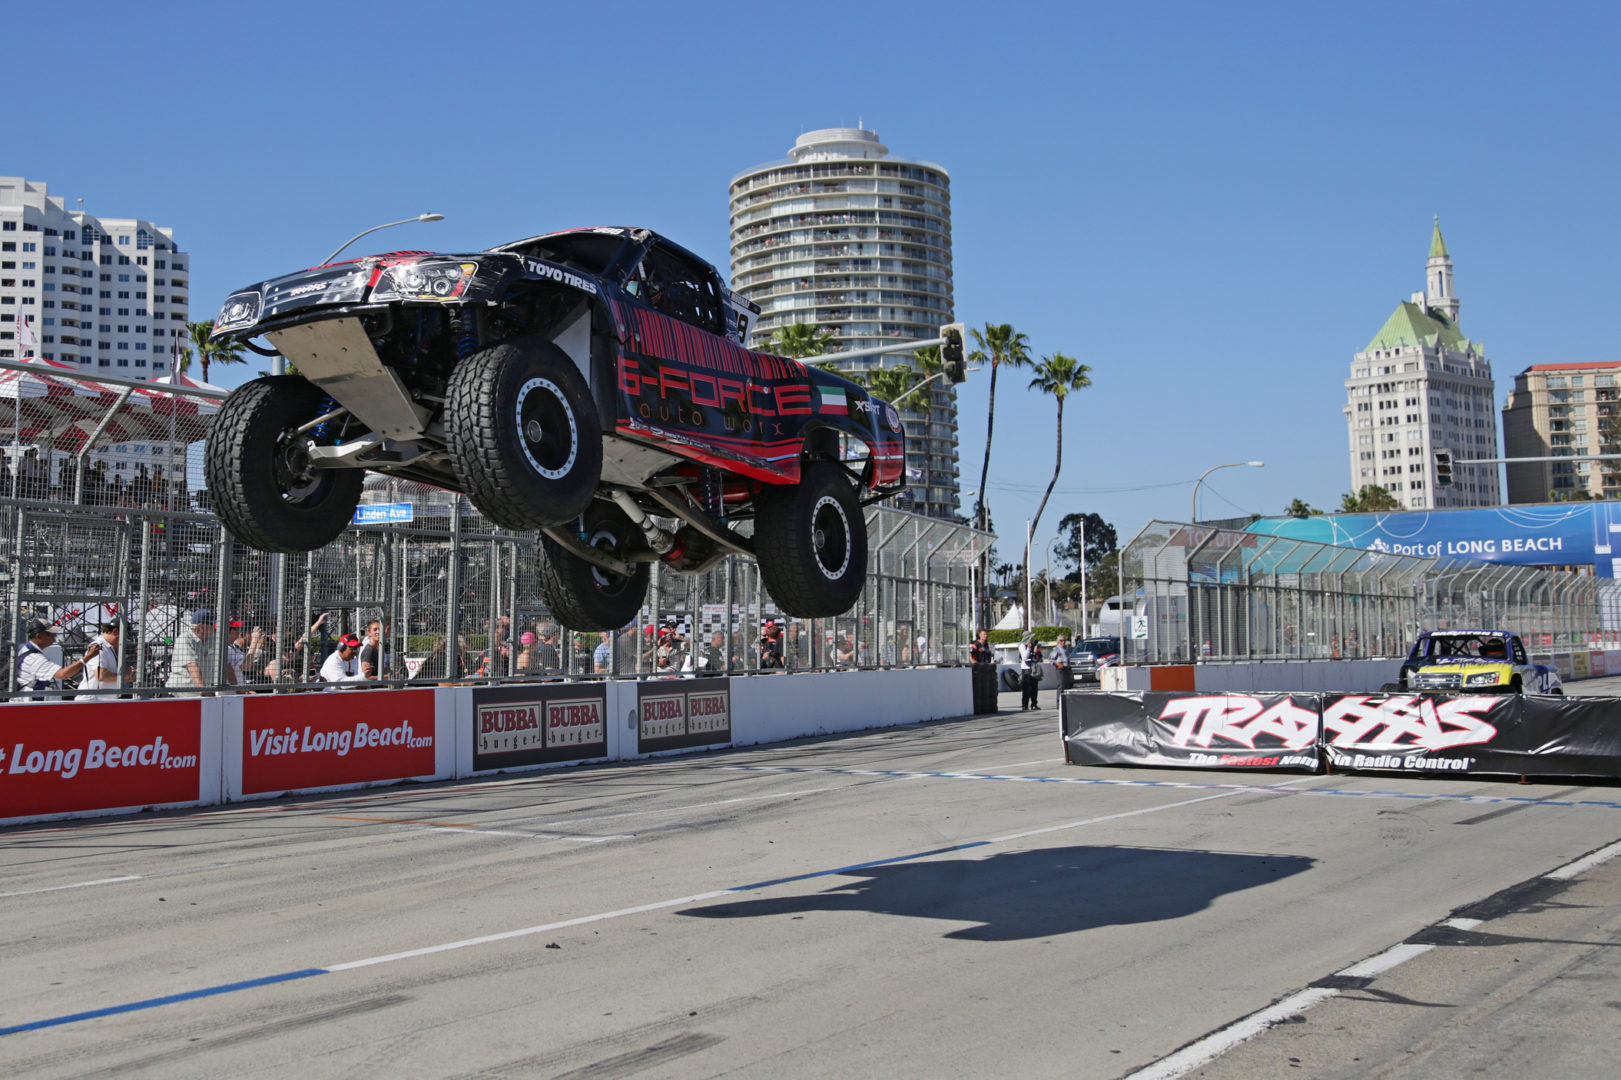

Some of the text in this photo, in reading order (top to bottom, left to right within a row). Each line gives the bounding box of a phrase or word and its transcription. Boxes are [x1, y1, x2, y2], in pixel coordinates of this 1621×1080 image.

[527, 260, 597, 294] TOYO TIRES
[617, 353, 812, 416] G-FORCE
[639, 402, 703, 425] auto
[723, 415, 785, 437] worx
[356, 507, 407, 520] Linden Ave
[1393, 537, 1562, 556] Port of LONG BEACH
[549, 704, 600, 728] BUBBA
[643, 699, 683, 721] BUBBA
[690, 696, 726, 717] BUBBA
[481, 708, 538, 733] BUBBA
[644, 722, 682, 736] burger
[1158, 695, 1501, 751] TRAXXAS
[250, 727, 299, 756] Visit
[301, 726, 352, 756] Long
[483, 734, 537, 750] burger
[551, 729, 599, 743] burger
[9, 743, 82, 779] Long
[1189, 752, 1469, 770] The Fastest Nam in Radio Control
